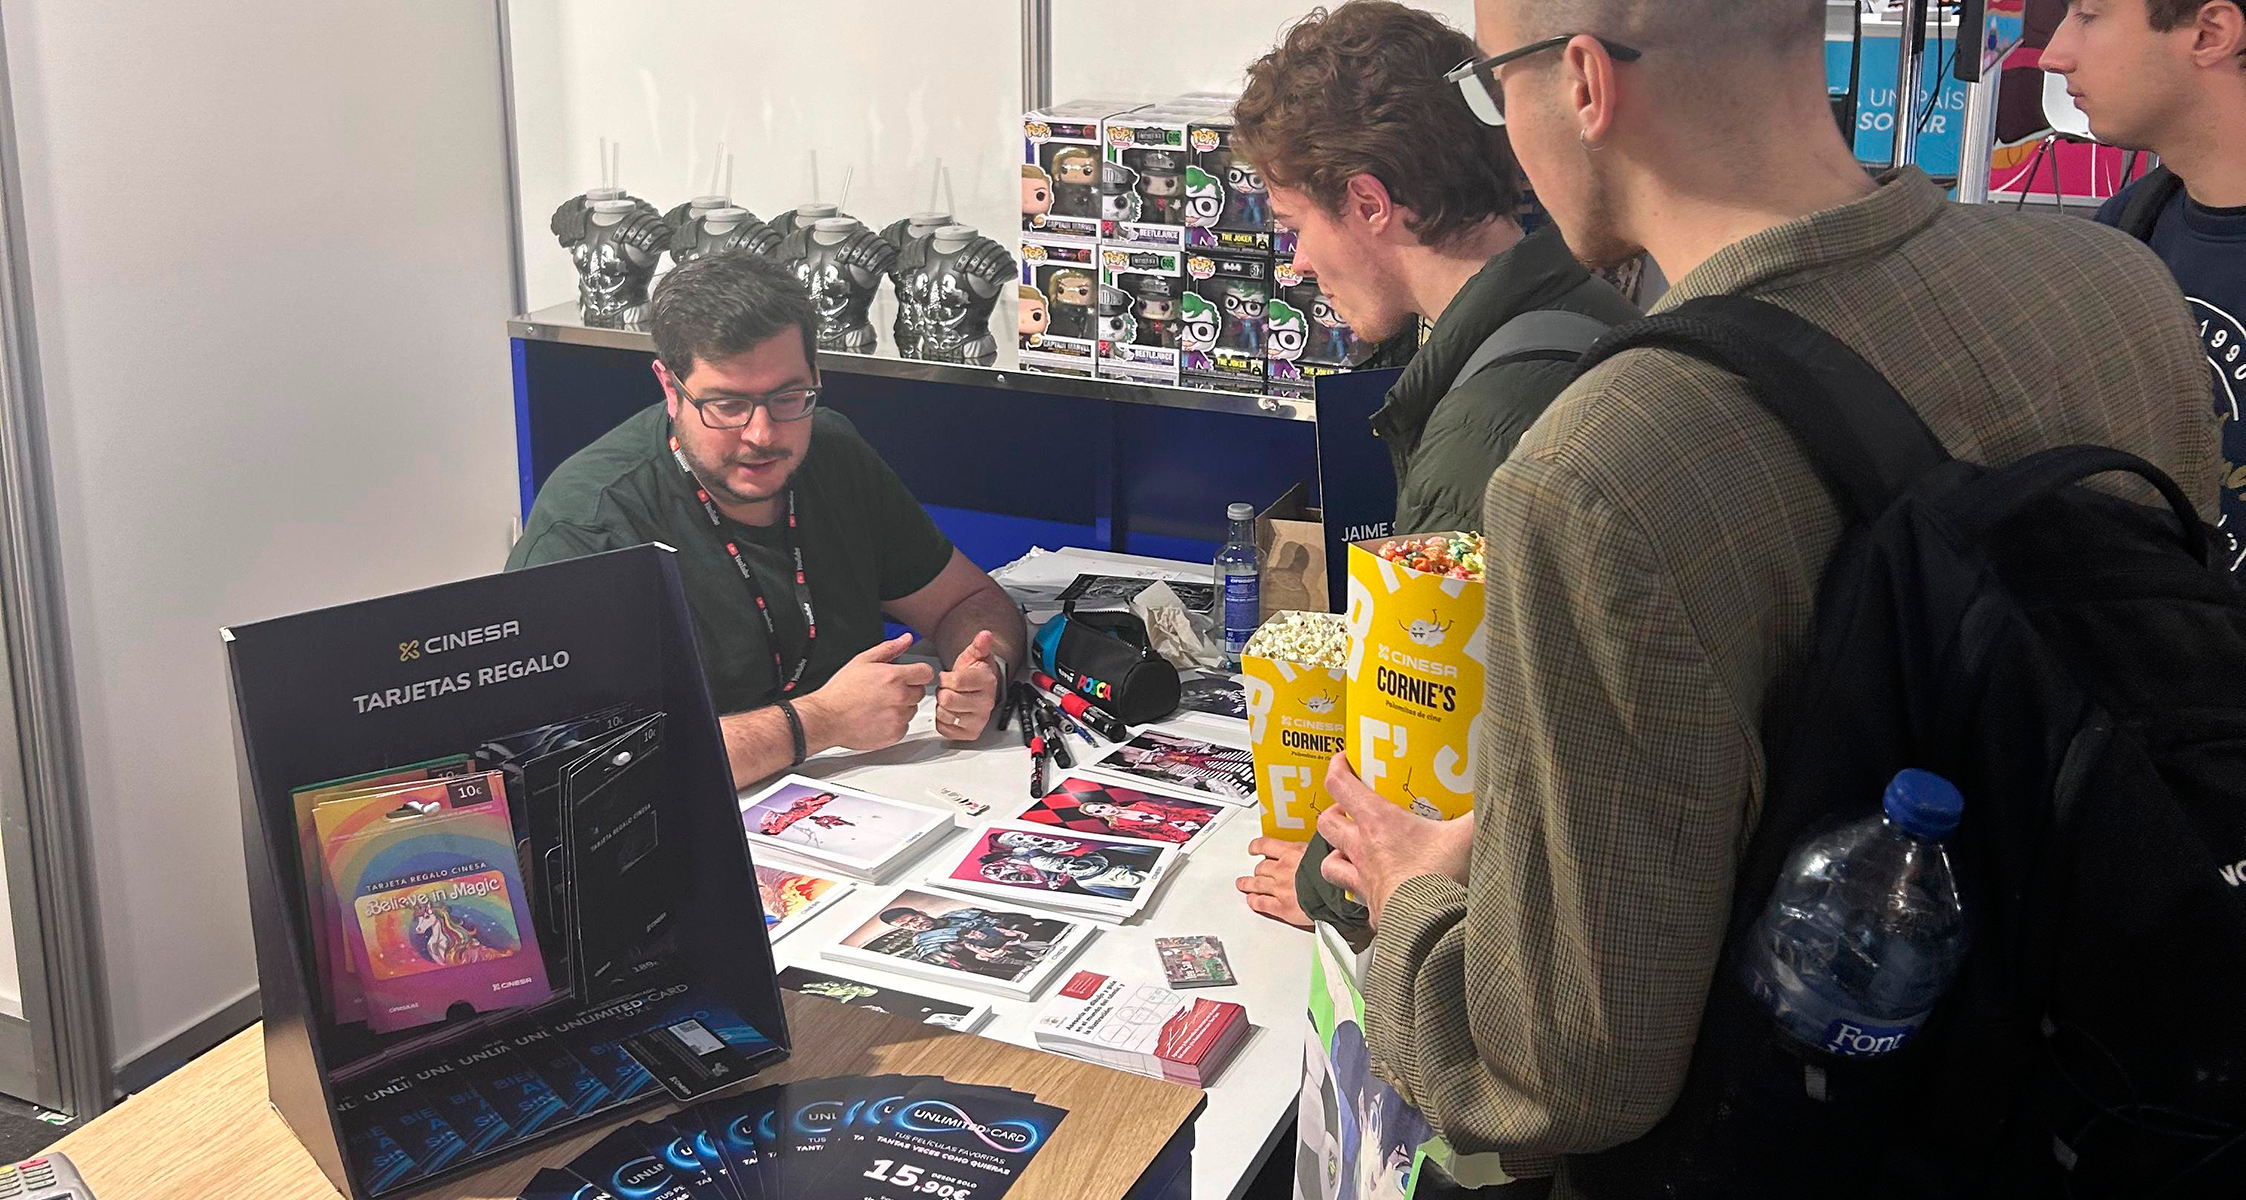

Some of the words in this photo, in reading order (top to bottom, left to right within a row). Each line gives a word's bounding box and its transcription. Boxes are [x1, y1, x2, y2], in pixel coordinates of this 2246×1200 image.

[1107, 126, 1135, 143] POP!
[1191, 129, 1219, 145] POP!
[1139, 229, 1178, 240] BEETLEJUICE
[1221, 233, 1234, 242] THE
[1234, 234, 1253, 243] JOKER
[1103, 251, 1129, 267] POP!
[1188, 257, 1215, 272] POP!
[1135, 350, 1173, 361] BEETLEJUICE
[1216, 358, 1228, 366] THE
[1228, 359, 1247, 368] JOKER
[1341, 521, 1388, 543] JAIME
[734, 554, 750, 579] YouTube
[424, 620, 520, 654] CINESA
[1390, 652, 1459, 678] CINESA
[353, 672, 471, 714] TARJETAS
[478, 650, 570, 686] REGALO
[1077, 674, 1112, 702] POSCA
[1376, 665, 1457, 712] CORNIE'S
[1385, 699, 1417, 717] Palomitas
[1417, 708, 1426, 718] de
[1426, 711, 1442, 723] cine
[1293, 718, 1345, 732] CINESA
[1281, 729, 1345, 753] CORNIE'S
[458, 784, 482, 799] 10€
[366, 877, 407, 892] TARJETA
[410, 869, 448, 883] REGALO
[451, 862, 487, 875] CINESA
[366, 891, 429, 918] Believe
[433, 888, 447, 902] in
[450, 877, 500, 900] Magic
[501, 976, 532, 990] CINESA
[555, 1000, 643, 1032] UNLIMITED
[648, 984, 689, 1002] CARD
[914, 1109, 986, 1133] UNLIMITED
[990, 1129, 1027, 1143] CARD
[876, 1135, 911, 1149] TANTAS
[912, 1144, 940, 1157] VECES
[941, 1152, 969, 1164] COMO
[970, 1160, 1011, 1176] QUIERAS
[894, 1131, 910, 1140] TUS
[911, 1135, 959, 1153] PELÍCULAS
[958, 1147, 1006, 1165] FAVORITAS
[863, 1158, 971, 1200] 15,90€
[931, 1172, 956, 1184] DESDE
[956, 1178, 978, 1189] SOLO
